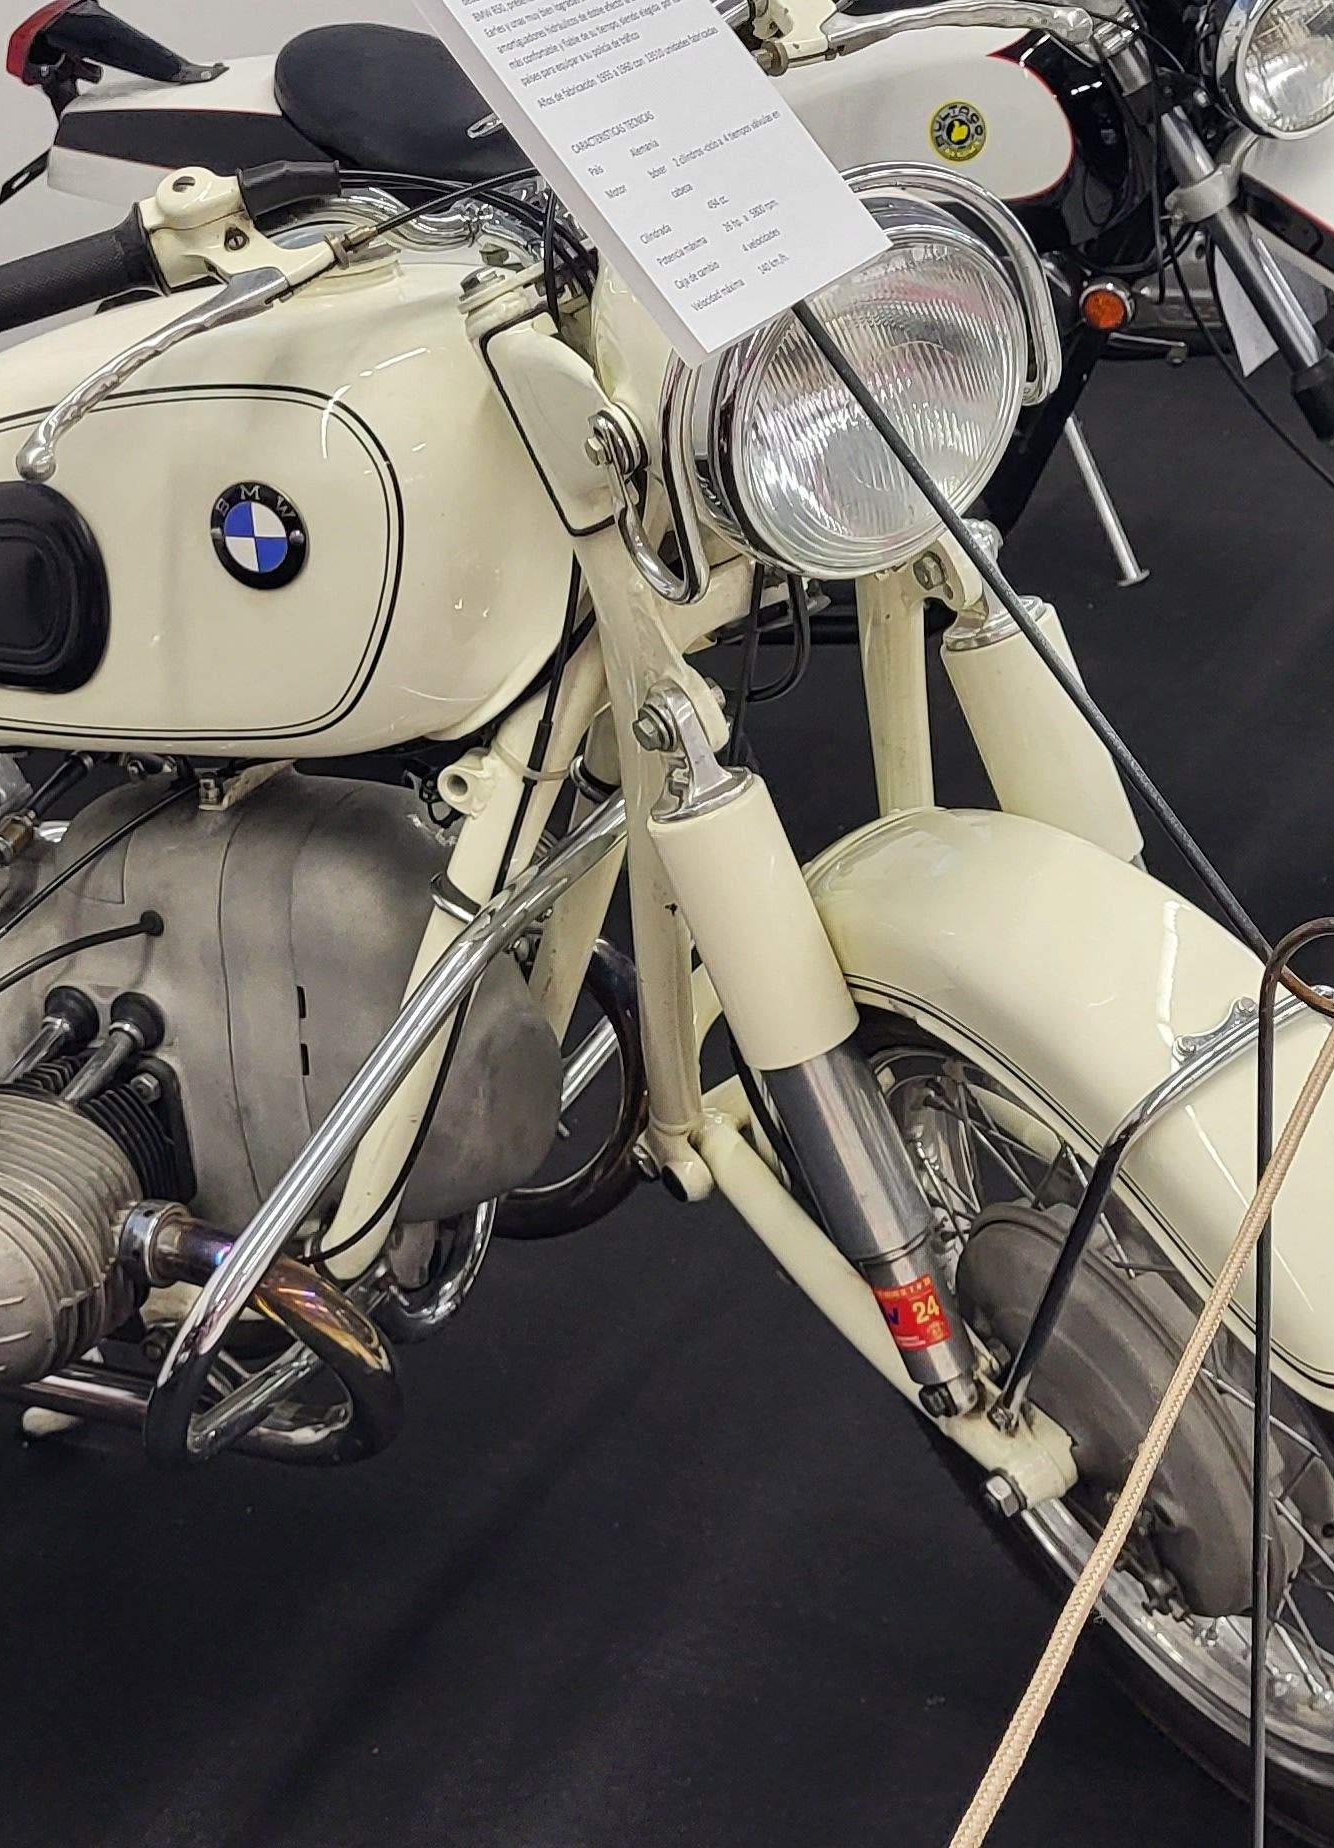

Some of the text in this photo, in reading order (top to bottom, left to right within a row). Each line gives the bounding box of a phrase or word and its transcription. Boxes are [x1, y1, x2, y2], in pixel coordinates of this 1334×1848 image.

[554, 93, 564, 101] de
[934, 104, 984, 148] BULTACO
[689, 273, 698, 282] de
[215, 484, 296, 517] BMW
[912, 1295, 940, 1325] 24
